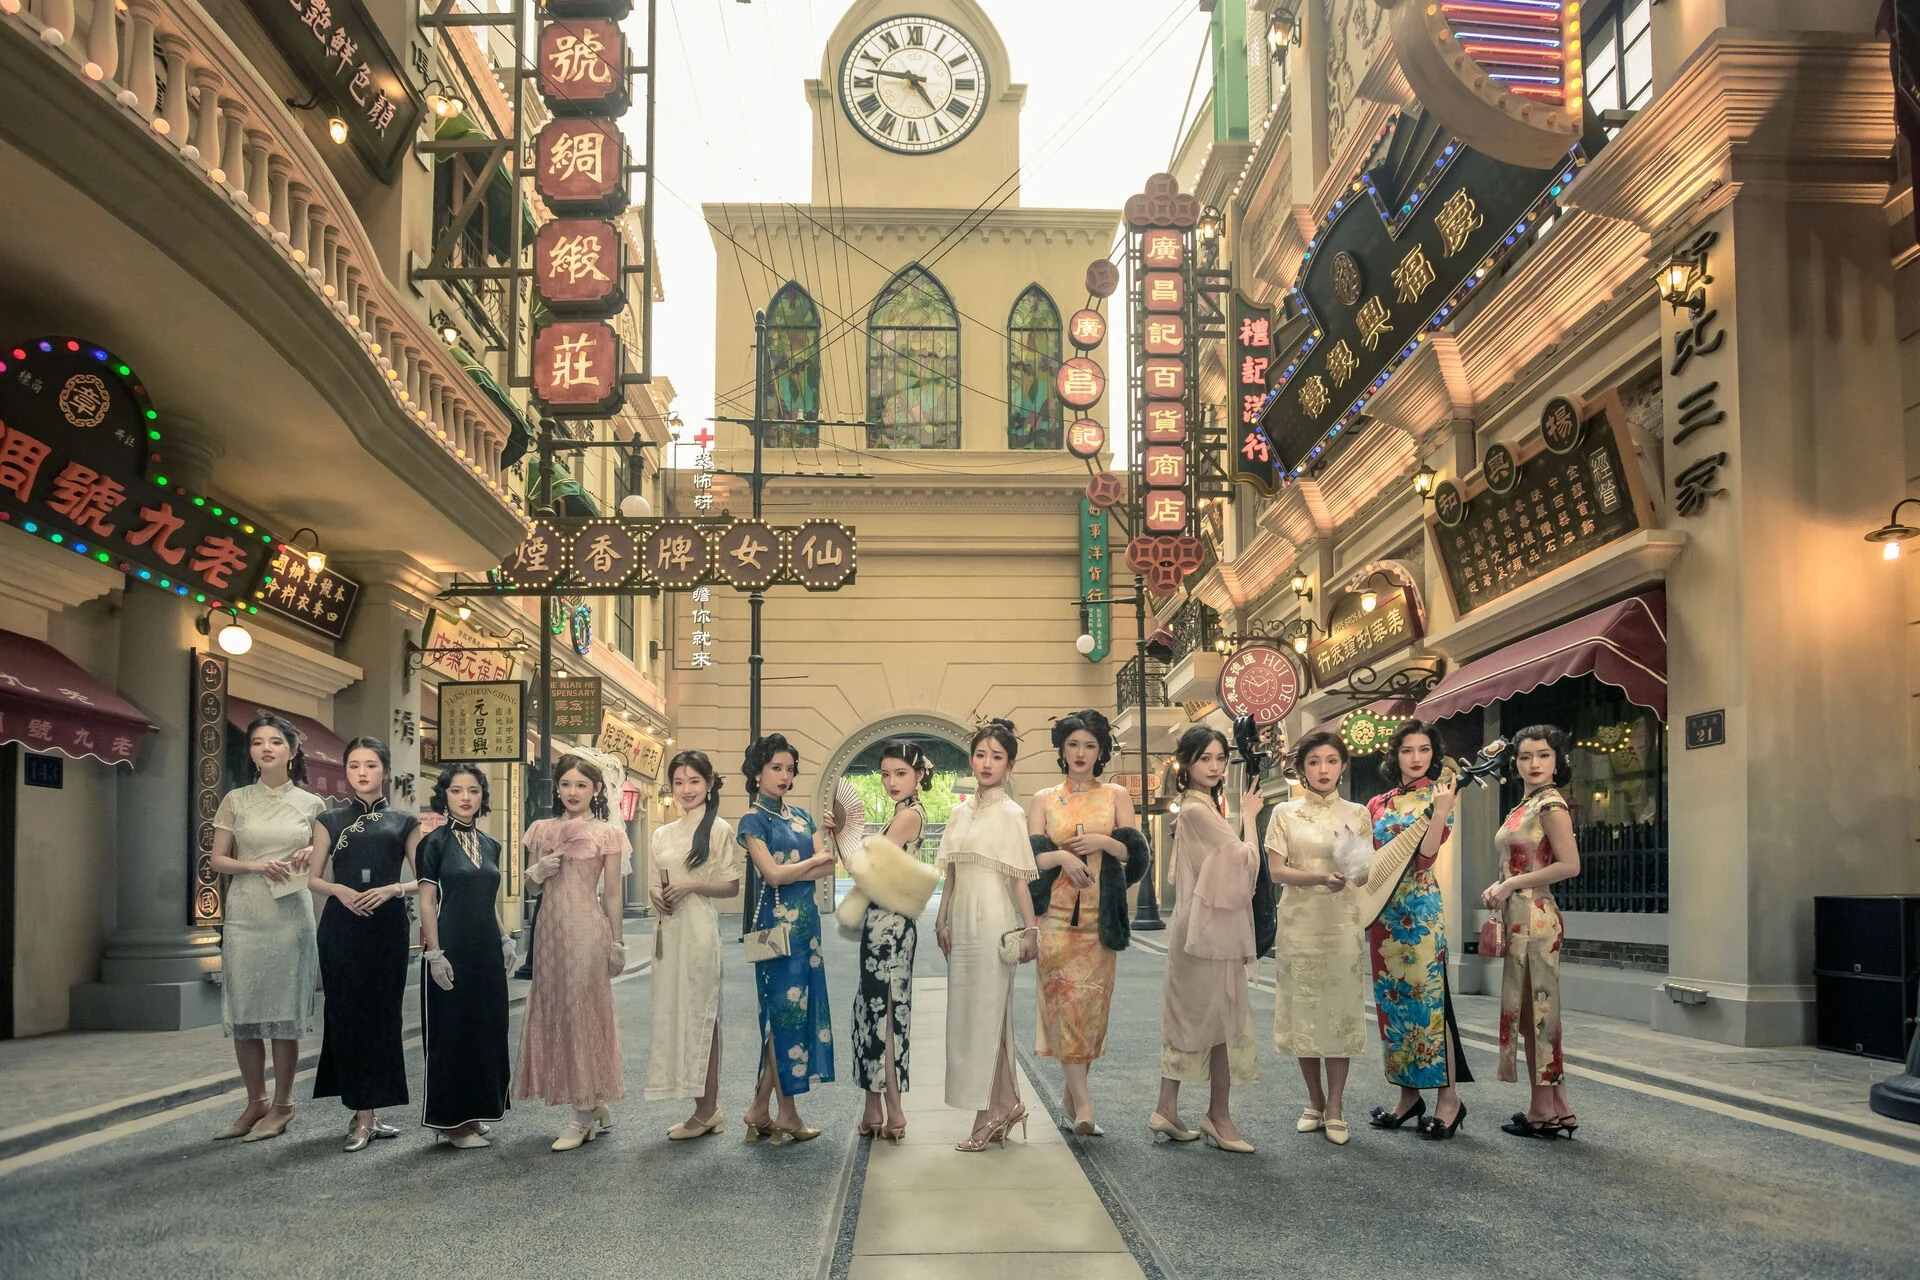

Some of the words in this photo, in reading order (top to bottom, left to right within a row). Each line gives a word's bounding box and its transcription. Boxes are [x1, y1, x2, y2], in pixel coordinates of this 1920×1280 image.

[548, 28, 611, 388] 號綢緞莊
[1064, 318, 1102, 447] 廣昌記
[1147, 236, 1183, 523] 廣昌記百貨商店
[1239, 317, 1269, 462] 禮記洋行
[513, 534, 842, 573] 仙女牌香煙
[551, 689, 596, 697] SPENSARY
[560, 681, 582, 689] NIAN
[584, 681, 595, 689] HE
[1262, 653, 1290, 676] HUI
[1279, 683, 1293, 703] DE
[0, 712, 133, 756] 老九號
[473, 699, 488, 755] 元昌興
[1696, 727, 1712, 743] 21
